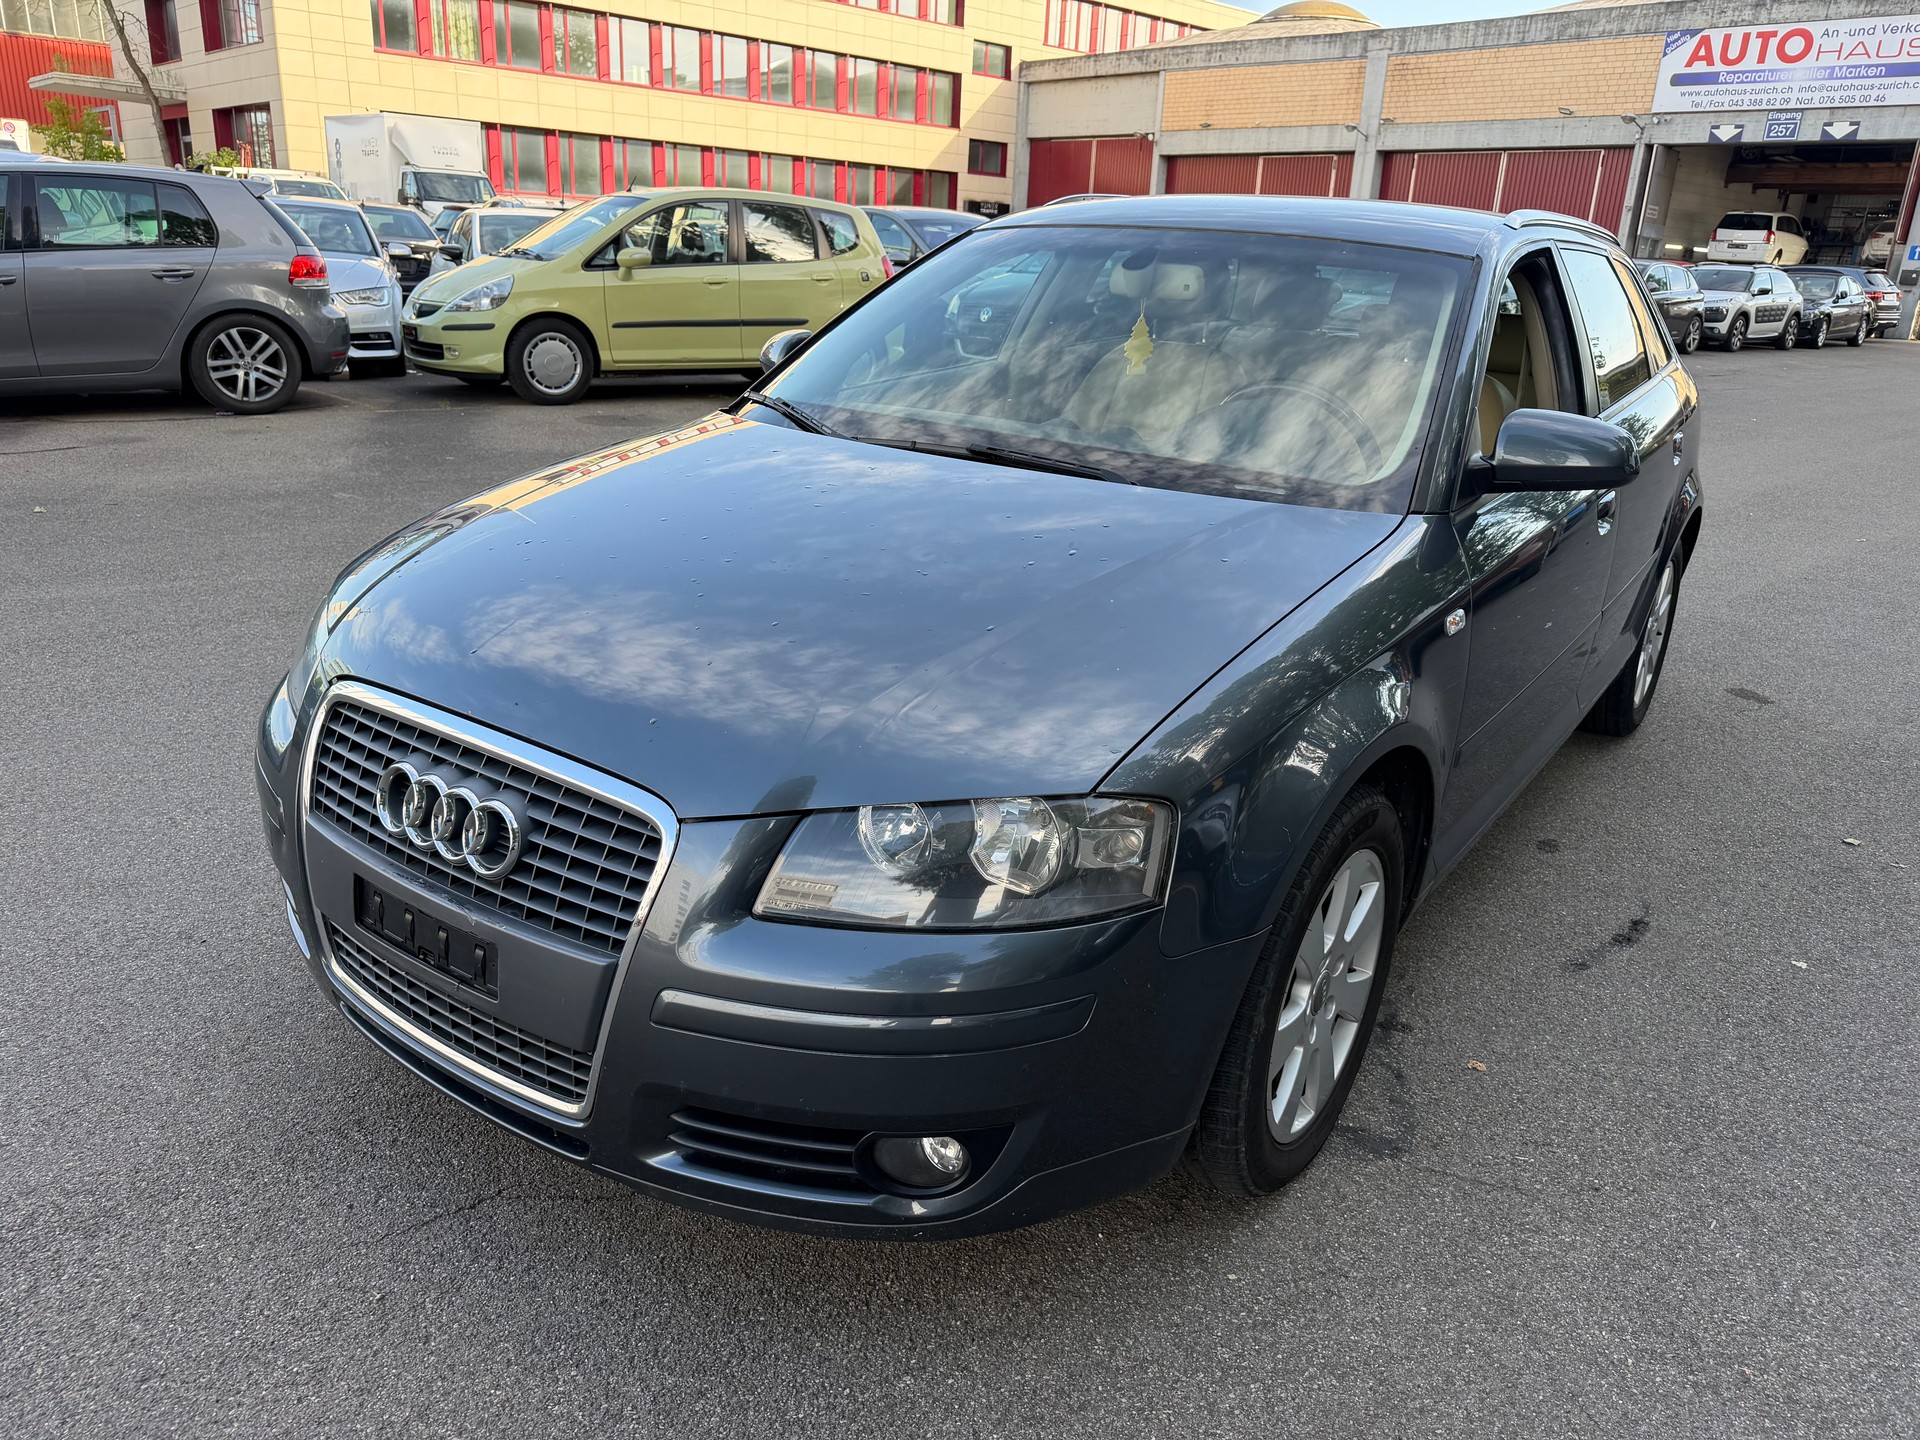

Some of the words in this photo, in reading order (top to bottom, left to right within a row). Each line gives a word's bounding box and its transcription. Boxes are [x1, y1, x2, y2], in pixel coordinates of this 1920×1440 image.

[1666, 32, 1681, 43] Hier
[1820, 28, 1839, 38] An
[1684, 27, 1814, 68] AUTO
[1833, 65, 1886, 78] Marken
[1680, 86, 1793, 97] www.autohaus-zurich.ch
[1797, 80, 1920, 93] info@autohaus-zurich.c
[1690, 99, 1725, 109] Tel./Fax
[1727, 98, 1744, 107] 043
[1746, 97, 1763, 107] 388
[1765, 97, 1777, 106] 82
[1779, 96, 1791, 106] 09
[1795, 96, 1816, 105] Nat.
[1818, 95, 1836, 105] 076
[1838, 94, 1857, 104] 505
[1858, 94, 1872, 103] 00
[1873, 93, 1887, 103] 46
[1768, 111, 1802, 120] Eingang
[1770, 125, 1794, 136] 257
